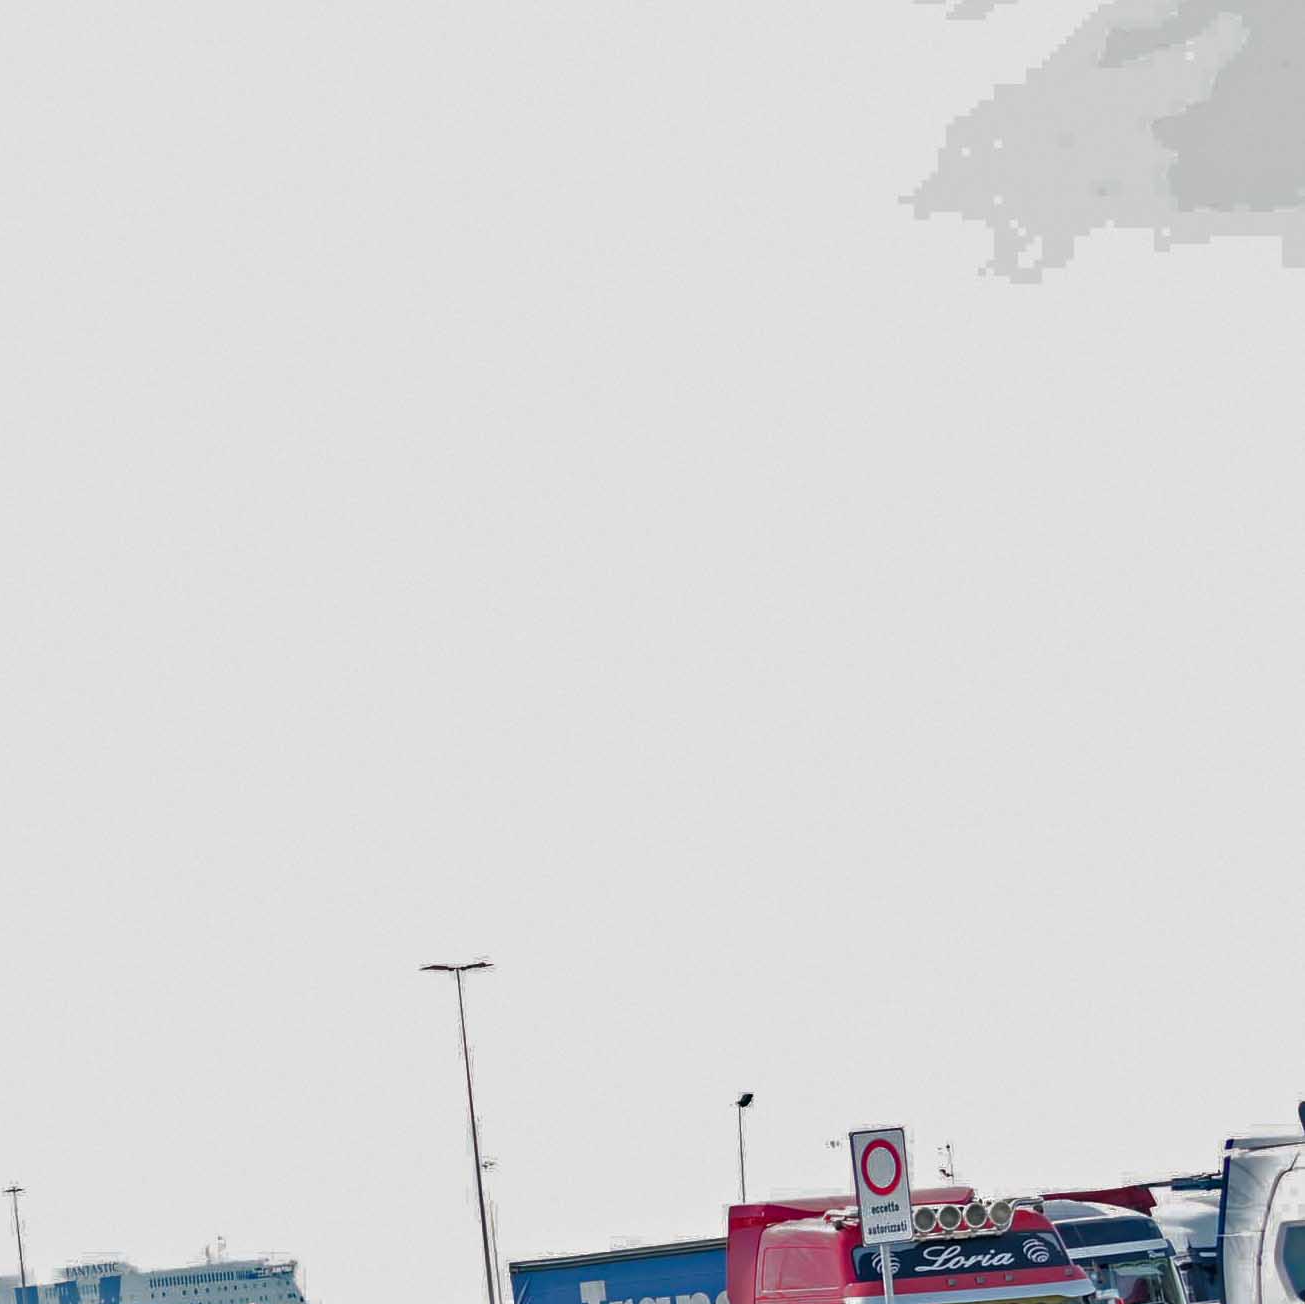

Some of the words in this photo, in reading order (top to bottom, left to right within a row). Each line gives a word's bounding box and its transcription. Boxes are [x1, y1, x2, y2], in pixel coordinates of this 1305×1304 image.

[871, 1203, 900, 1215] eccetto
[868, 1222, 908, 1236] autorizzati
[914, 1245, 1015, 1273] Loria
[65, 1261, 119, 1280] FANTASTIC
